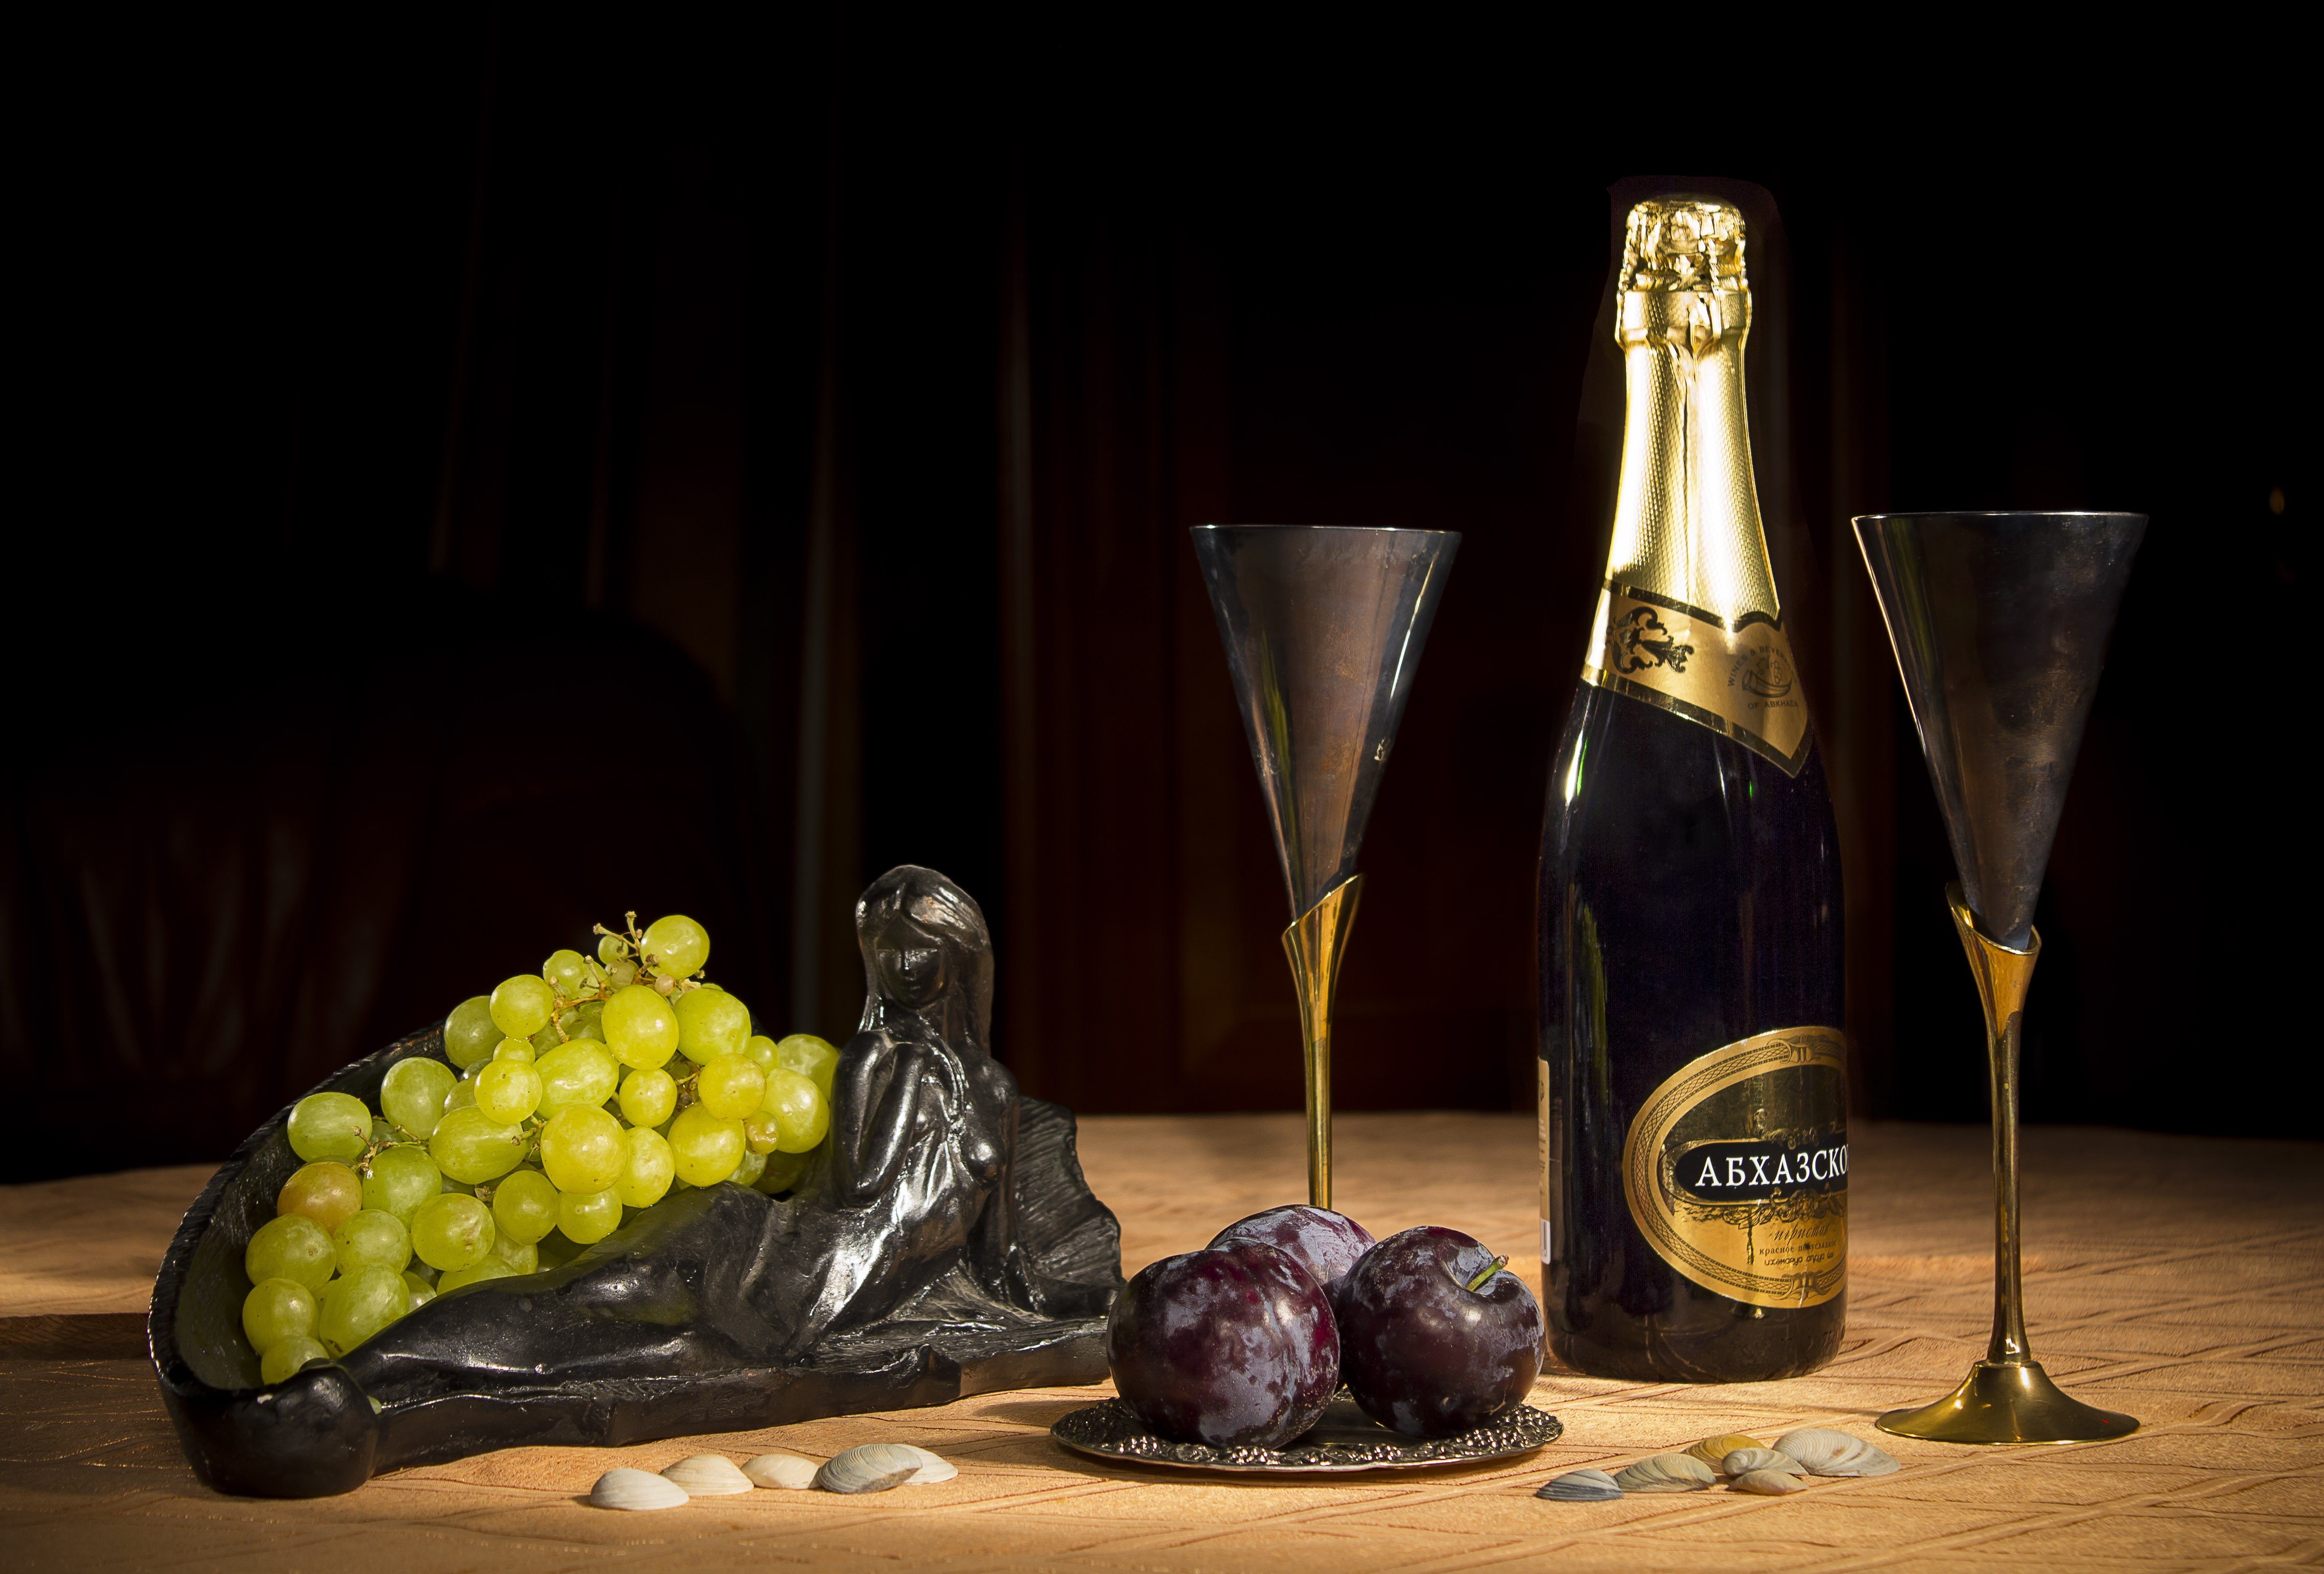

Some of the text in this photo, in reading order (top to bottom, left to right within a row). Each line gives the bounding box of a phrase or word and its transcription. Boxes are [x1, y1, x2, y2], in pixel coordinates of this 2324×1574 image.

[1728, 655, 1748, 686] WINES
[1695, 1143, 1848, 1187] АБХАЗСКО
[1760, 1247, 1794, 1256] красное
